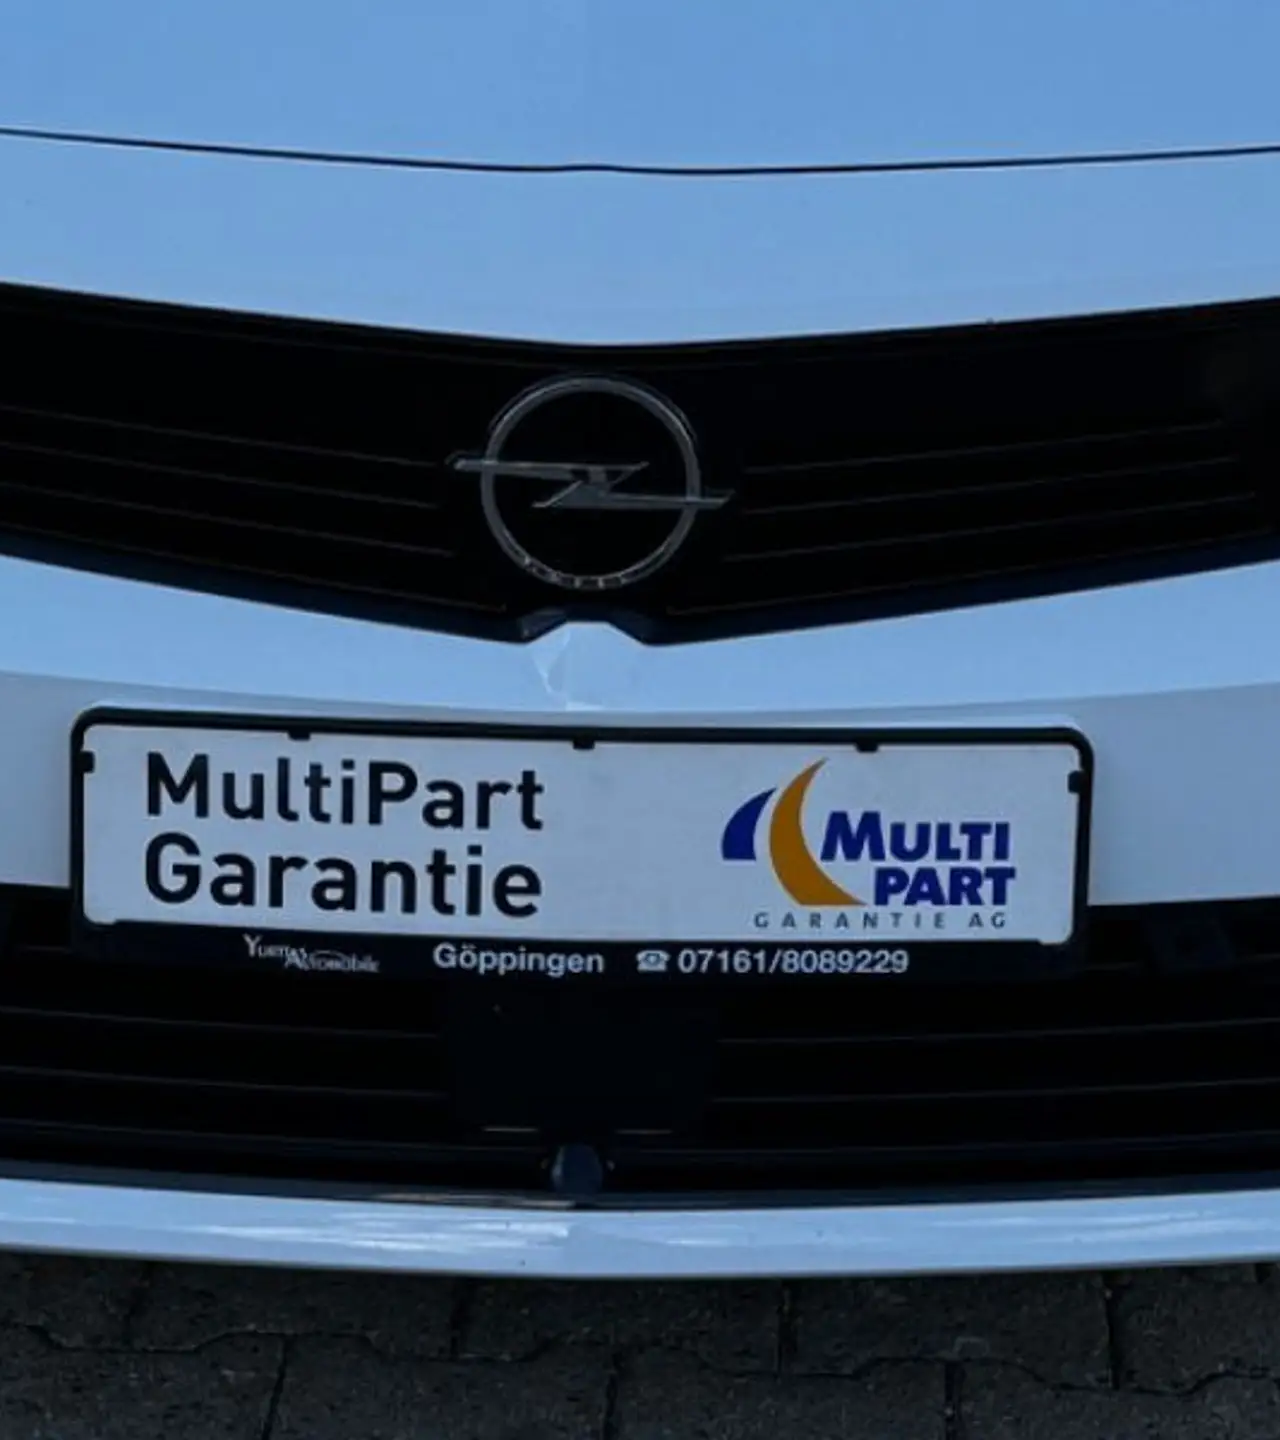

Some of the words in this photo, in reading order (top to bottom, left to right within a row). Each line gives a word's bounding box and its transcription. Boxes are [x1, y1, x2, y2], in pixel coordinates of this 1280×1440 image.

[147, 752, 544, 830] MultiPart
[145, 832, 543, 918] Garantie
[874, 866, 1016, 906] PART
[753, 912, 946, 929] GARANTIE
[969, 912, 1006, 929] AG
[433, 942, 604, 978] Göppingen
[677, 949, 909, 974] 07161/8089229
